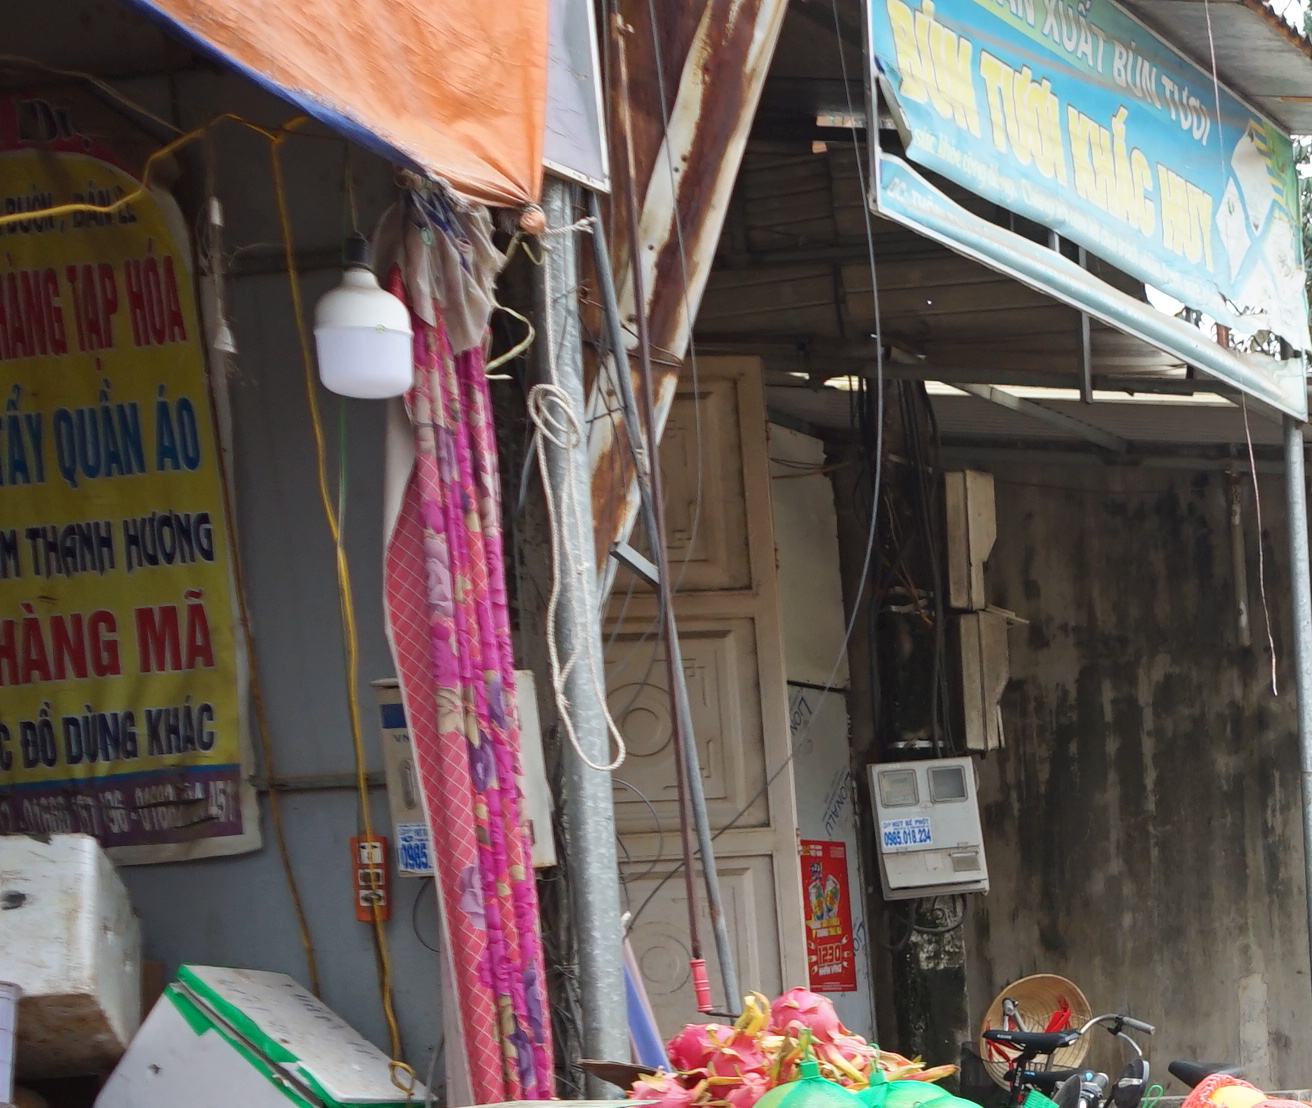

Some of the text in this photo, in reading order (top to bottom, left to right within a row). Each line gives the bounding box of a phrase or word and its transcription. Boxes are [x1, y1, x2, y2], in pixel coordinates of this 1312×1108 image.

[1041, 0, 1103, 73] XUẤT
[1112, 39, 1162, 110] BÚN
[1161, 75, 1210, 146] TƯƠI
[979, 48, 1067, 185] TƯƠI
[1067, 103, 1157, 238] KHẮC
[1156, 161, 1214, 273] HUY
[66, 263, 119, 373] TẠP
[123, 237, 188, 347] HÓA
[54, 378, 147, 488] QUẦN
[156, 384, 201, 471] ÁO
[123, 509, 215, 573] HƯƠNG
[134, 589, 215, 674] MÃ
[19, 702, 58, 769] ĐỒ
[62, 704, 139, 766] DÙNG
[144, 695, 216, 757] KHÁC
